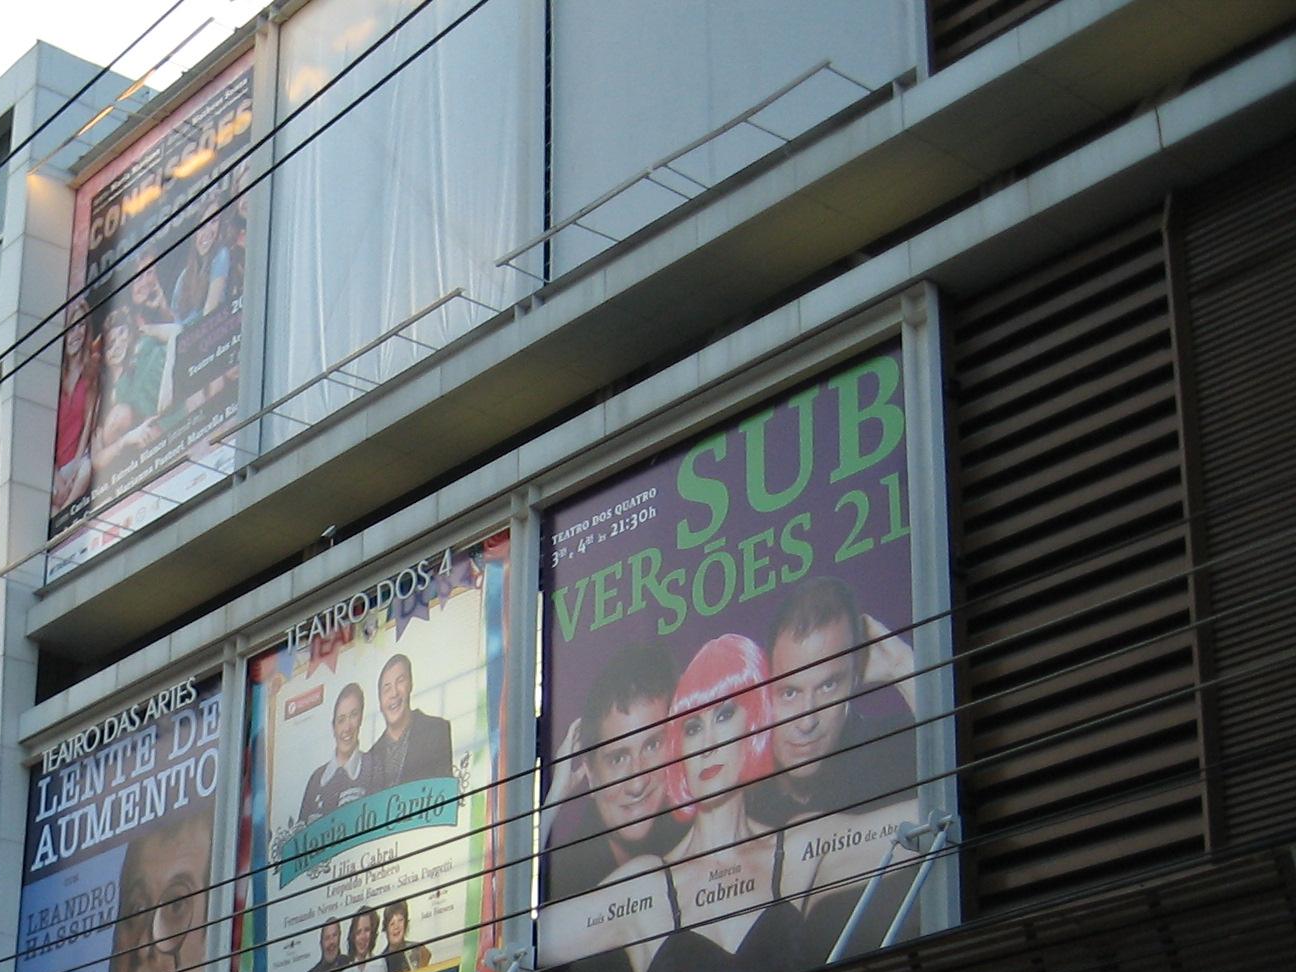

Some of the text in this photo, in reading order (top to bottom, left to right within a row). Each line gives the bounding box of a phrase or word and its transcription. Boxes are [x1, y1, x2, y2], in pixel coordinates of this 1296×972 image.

[676, 355, 906, 550] SUB
[551, 487, 657, 546] TEATRO DOS QUATRO
[610, 506, 657, 538] 21:30h
[551, 472, 911, 643] VERSÕES 21
[284, 547, 453, 655] TEATRO DOS 4
[41, 675, 198, 776] TEATRO DAS ARTES
[34, 723, 158, 823] LENTE
[167, 697, 223, 761] DE
[30, 746, 220, 872] AUMENTO
[353, 801, 378, 833] do
[386, 785, 448, 831] Carito
[360, 841, 399, 867] Cabral
[801, 828, 863, 861] Aloisio
[863, 830, 878, 843] de
[26, 881, 117, 937] LEANDRO
[606, 895, 654, 922] Salem
[695, 877, 756, 908] Cabrita
